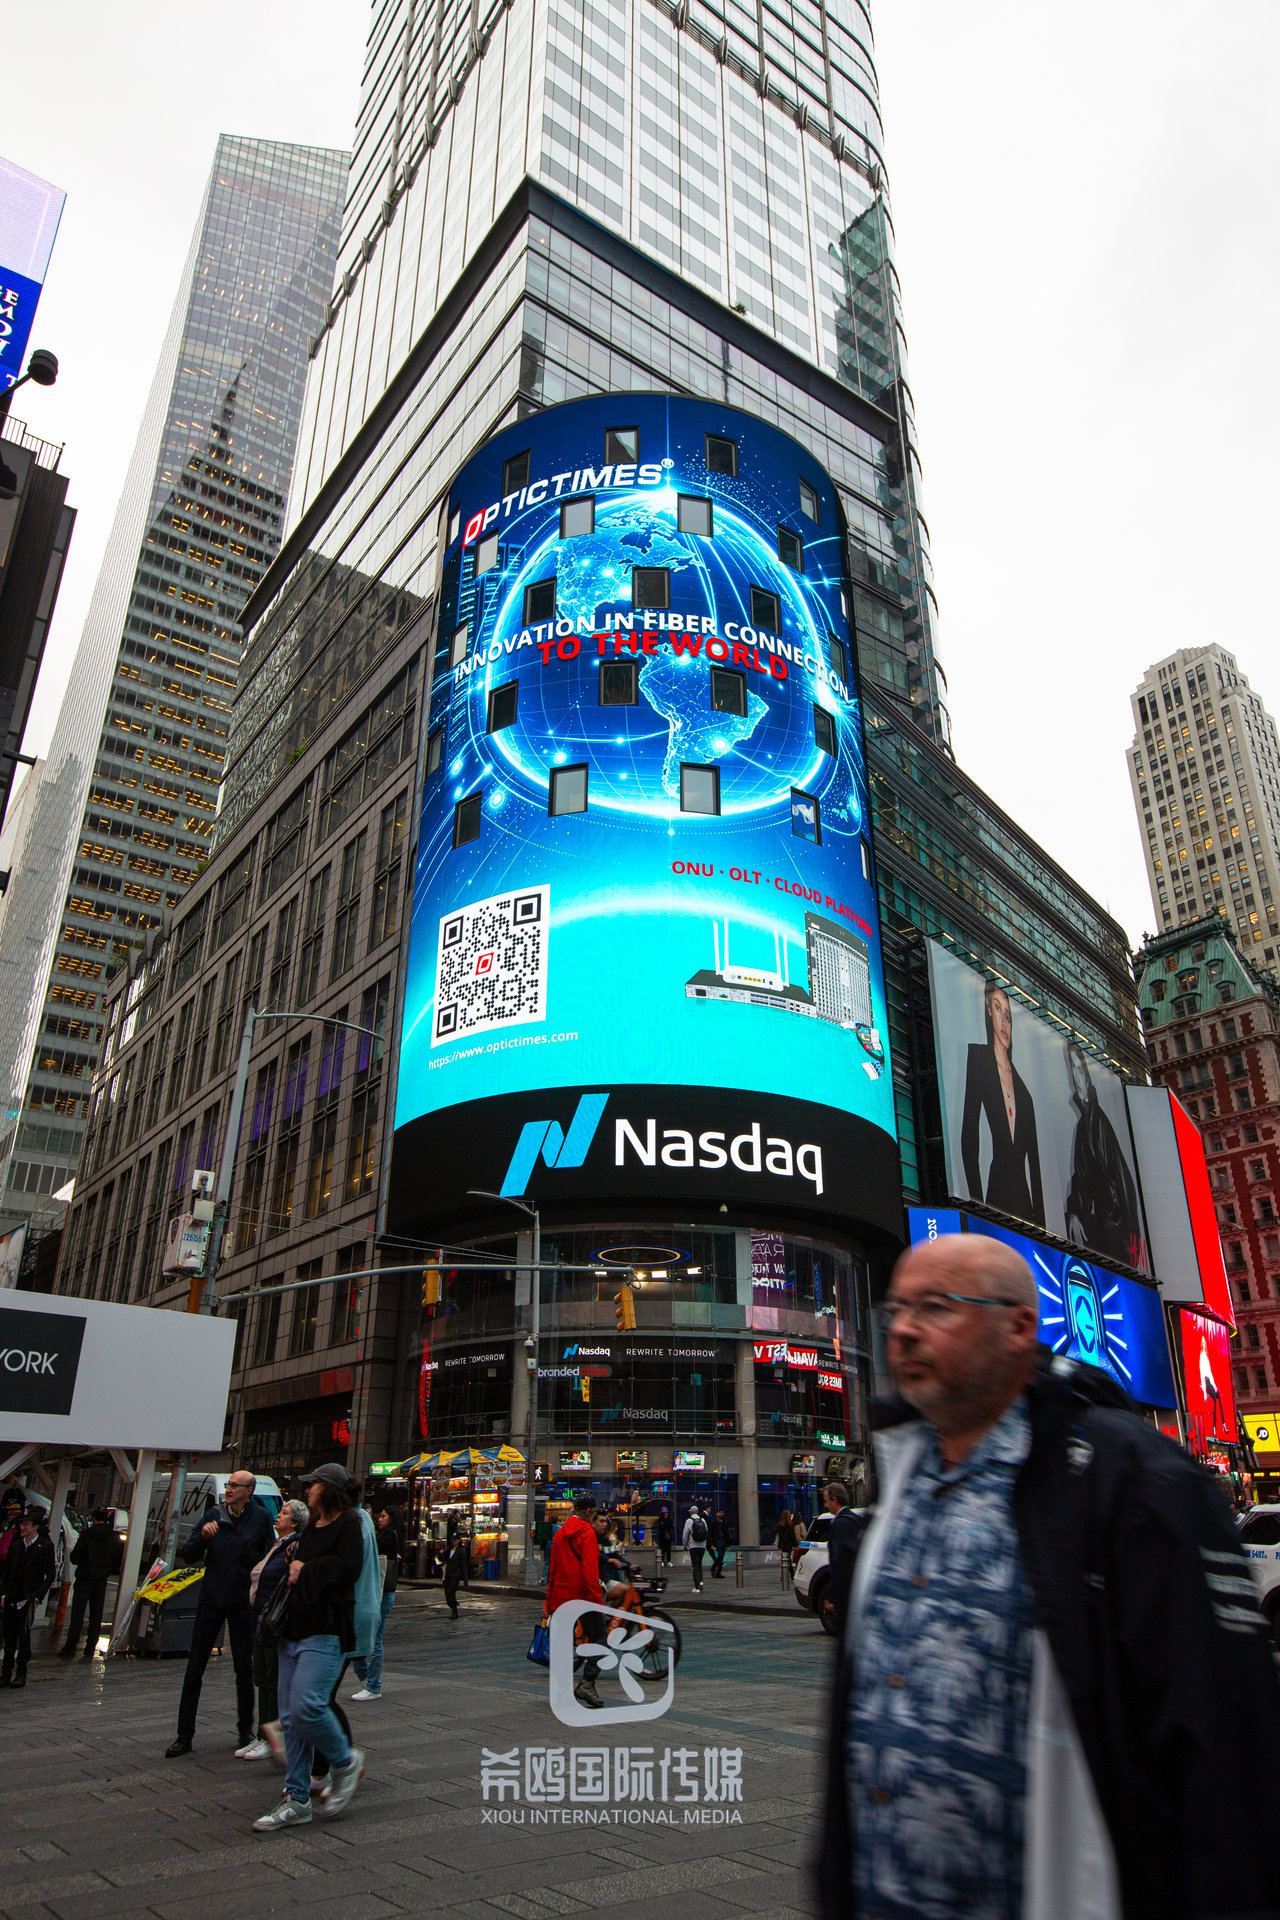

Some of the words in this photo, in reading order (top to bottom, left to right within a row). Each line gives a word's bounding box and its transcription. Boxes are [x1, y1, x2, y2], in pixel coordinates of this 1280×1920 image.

[454, 614, 595, 684] INNOVATION
[605, 612, 634, 630] IN
[643, 612, 717, 635] FIBER
[724, 622, 849, 703] CONNECTION
[537, 636, 581, 665] TO
[592, 631, 659, 655] THE
[669, 632, 788, 680] WORLD
[671, 860, 714, 877] ONU
[729, 867, 762, 884] OLT
[774, 877, 822, 904] CLOUD
[825, 895, 873, 938] PLATFORM
[428, 1032, 579, 1071] https://www.optictimes.com
[614, 1118, 824, 1195] Nasdaq
[445, 1357, 467, 1367] REWRITE
[469, 1354, 505, 1364] TOMORROW
[537, 1366, 609, 1378] brandedcities
[578, 1347, 611, 1358] Nasdaq
[626, 1348, 664, 1356] REWRITE
[668, 1348, 716, 1357] TOMORROW
[622, 1408, 668, 1422] Nasdaq
